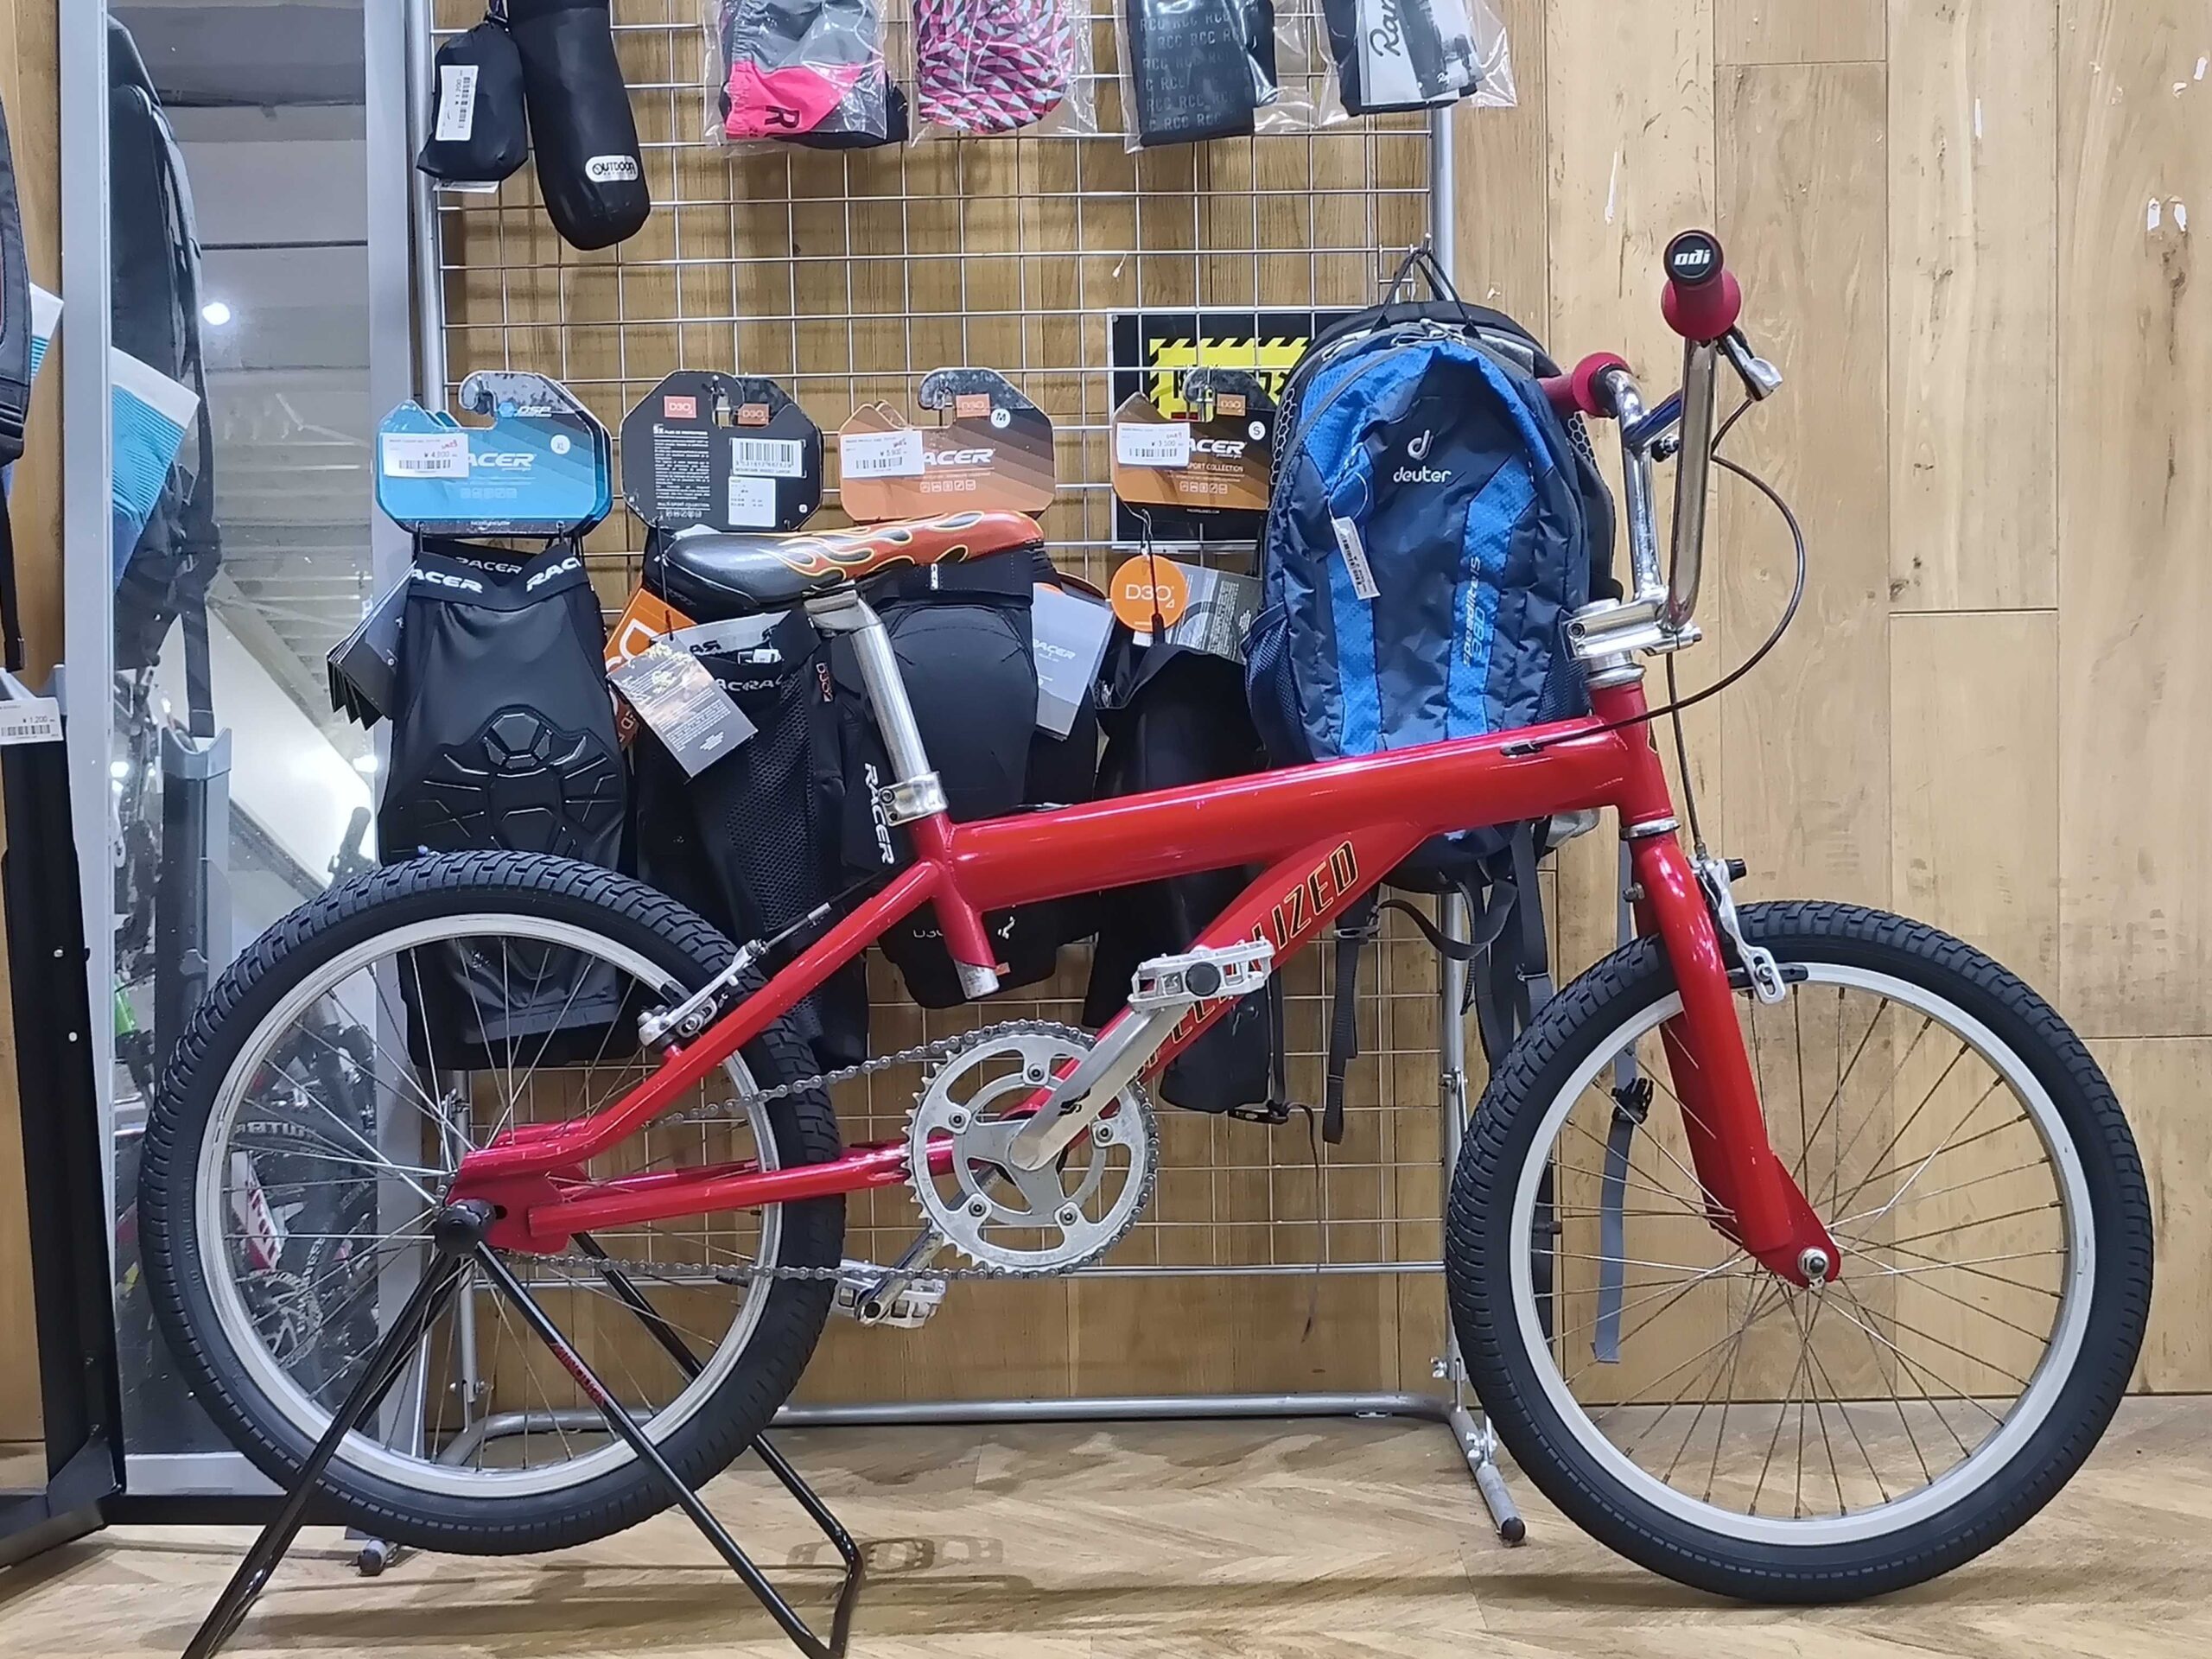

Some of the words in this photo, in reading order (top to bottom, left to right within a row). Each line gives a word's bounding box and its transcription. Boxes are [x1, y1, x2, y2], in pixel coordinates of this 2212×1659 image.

[1674, 249, 1711, 265] odi
[995, 412, 1007, 422] M
[1253, 426, 1261, 435] S
[1189, 438, 1245, 454] ACER
[468, 453, 535, 467] ACER
[923, 448, 994, 466] ACER
[1393, 465, 1452, 482] deuter
[410, 568, 483, 594] ACER
[1126, 584, 1172, 601] D3O
[864, 762, 895, 864] RACER
